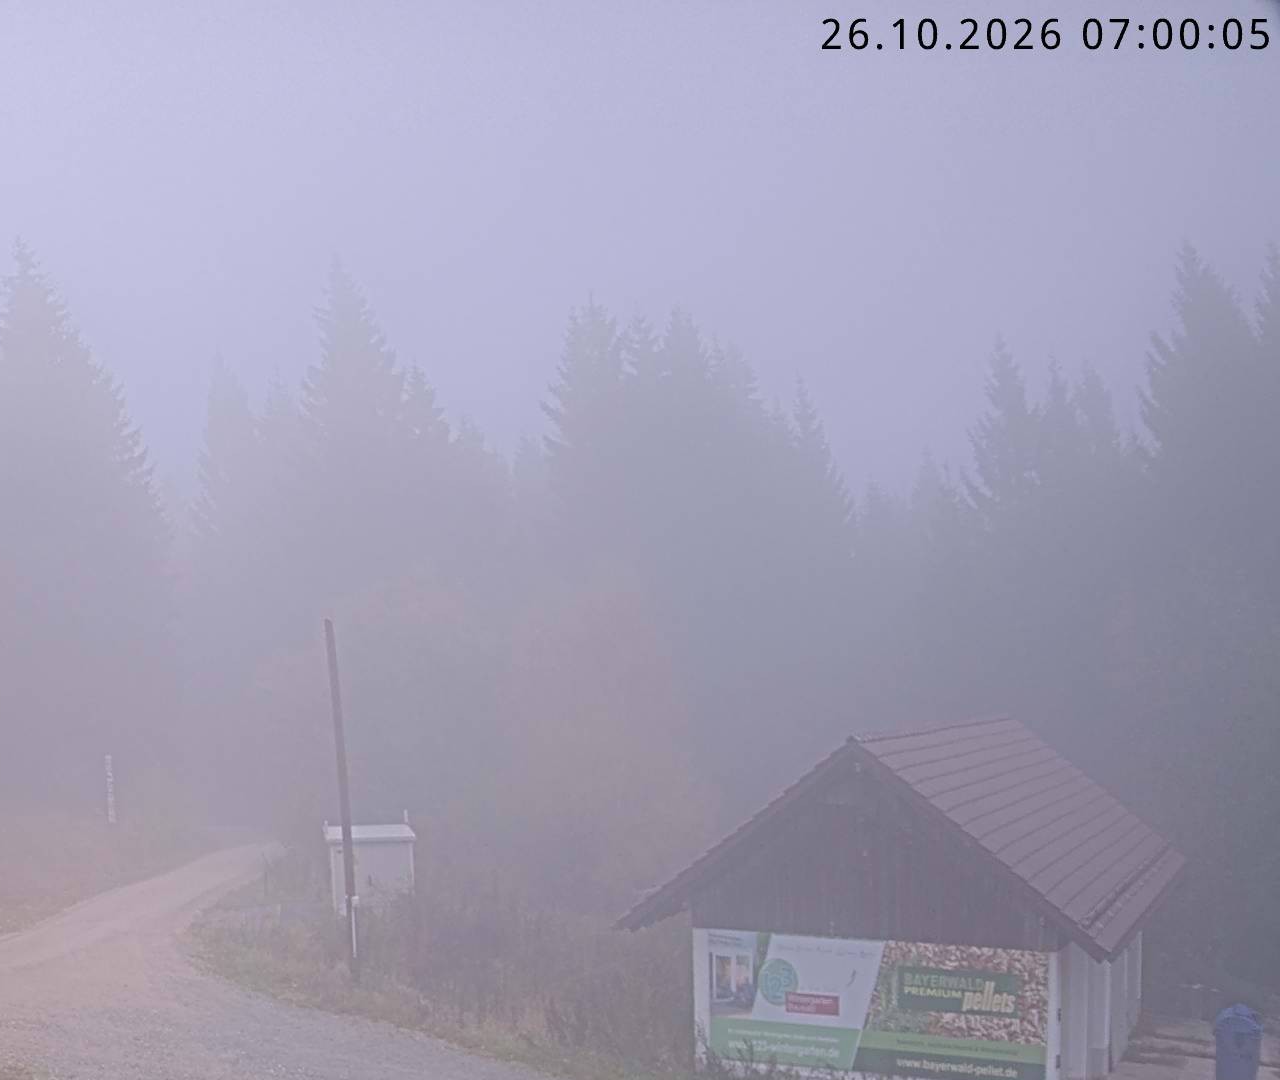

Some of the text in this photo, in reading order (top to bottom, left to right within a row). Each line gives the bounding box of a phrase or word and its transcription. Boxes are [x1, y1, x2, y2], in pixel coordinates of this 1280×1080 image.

[903, 972, 985, 991] BAYERWALD
[903, 981, 1017, 1013] PREMIUM pellets
